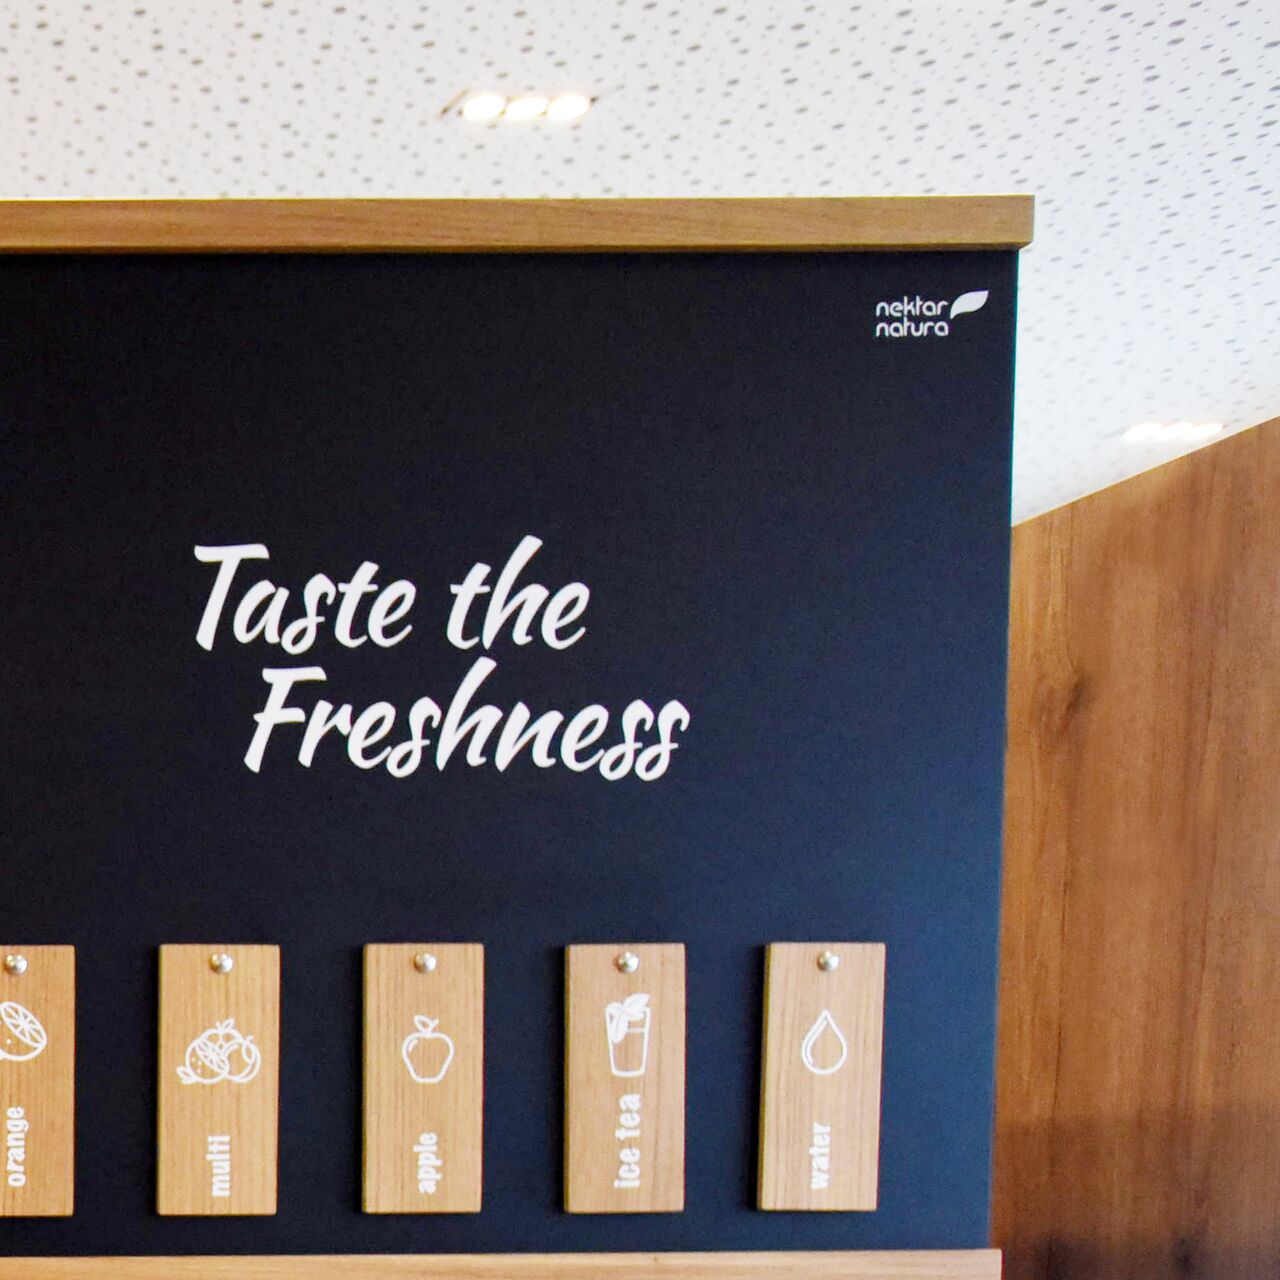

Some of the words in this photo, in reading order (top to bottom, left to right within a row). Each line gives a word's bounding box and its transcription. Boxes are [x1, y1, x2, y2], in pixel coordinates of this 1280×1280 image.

[875, 295, 949, 317] nektar
[875, 316, 949, 337] natura
[194, 543, 416, 655] Taste
[446, 534, 591, 650] the
[243, 655, 690, 782] Freshness
[5, 1105, 30, 1188] orange
[613, 1092, 641, 1141] tea
[205, 1134, 231, 1198] multi
[411, 1131, 444, 1195] apple
[612, 1146, 641, 1189] ice
[808, 1120, 832, 1191] water
